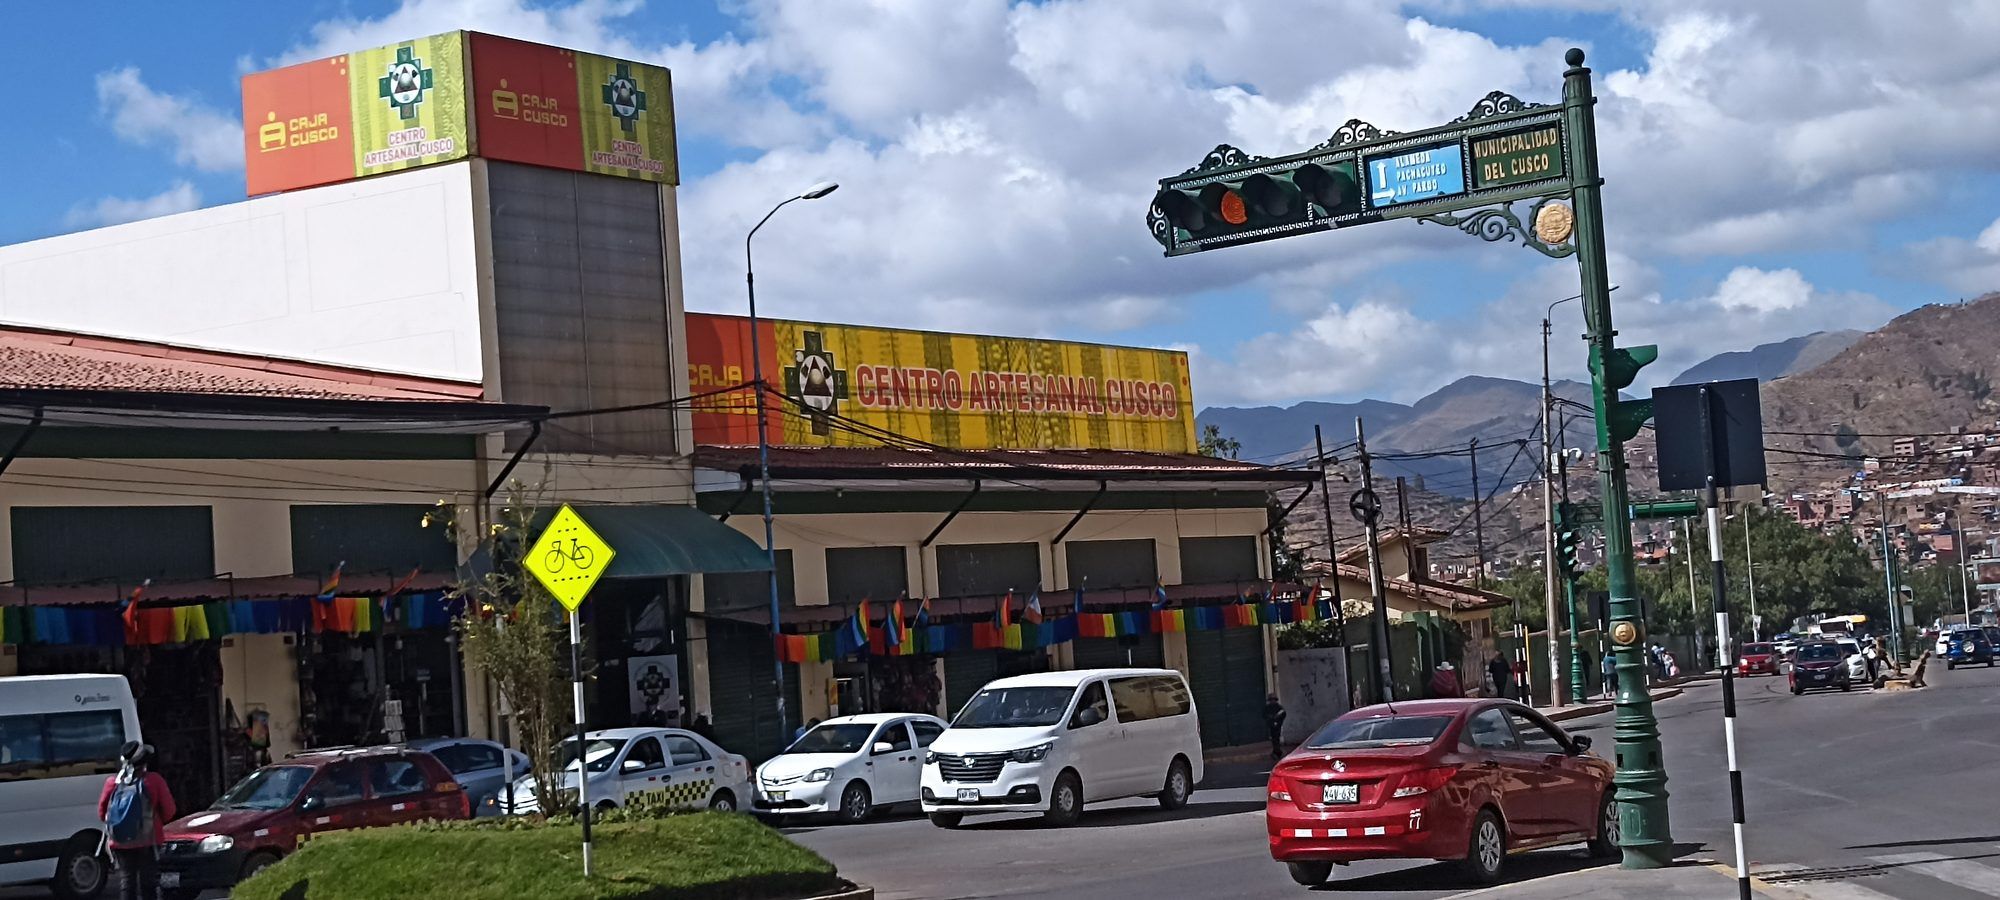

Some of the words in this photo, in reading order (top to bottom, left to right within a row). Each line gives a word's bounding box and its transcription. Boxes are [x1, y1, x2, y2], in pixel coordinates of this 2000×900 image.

[522, 94, 558, 111] CAJA
[289, 112, 328, 132] CAJA
[523, 109, 568, 128] CUSCO
[290, 126, 338, 147] CUSCO
[388, 127, 426, 146] CENTRO
[1473, 127, 1557, 158] MUNICIPALIDAD
[365, 144, 419, 167] ARTESANAL
[419, 138, 453, 156] CUSCO
[612, 139, 643, 156] CENTRO
[592, 151, 638, 170] ARTESANAL
[638, 159, 665, 173] CUSCO
[1395, 151, 1432, 169] ALAMEDA
[1484, 161, 1506, 180] DEL
[1511, 153, 1549, 175] CUSCO
[1412, 179, 1438, 194] PARDO
[687, 363, 743, 387] CAJA
[856, 364, 963, 411] CENTRO
[968, 371, 1105, 414] ARTESANAL
[1105, 378, 1178, 420] CUSCO
[646, 791, 665, 805] TAXI
